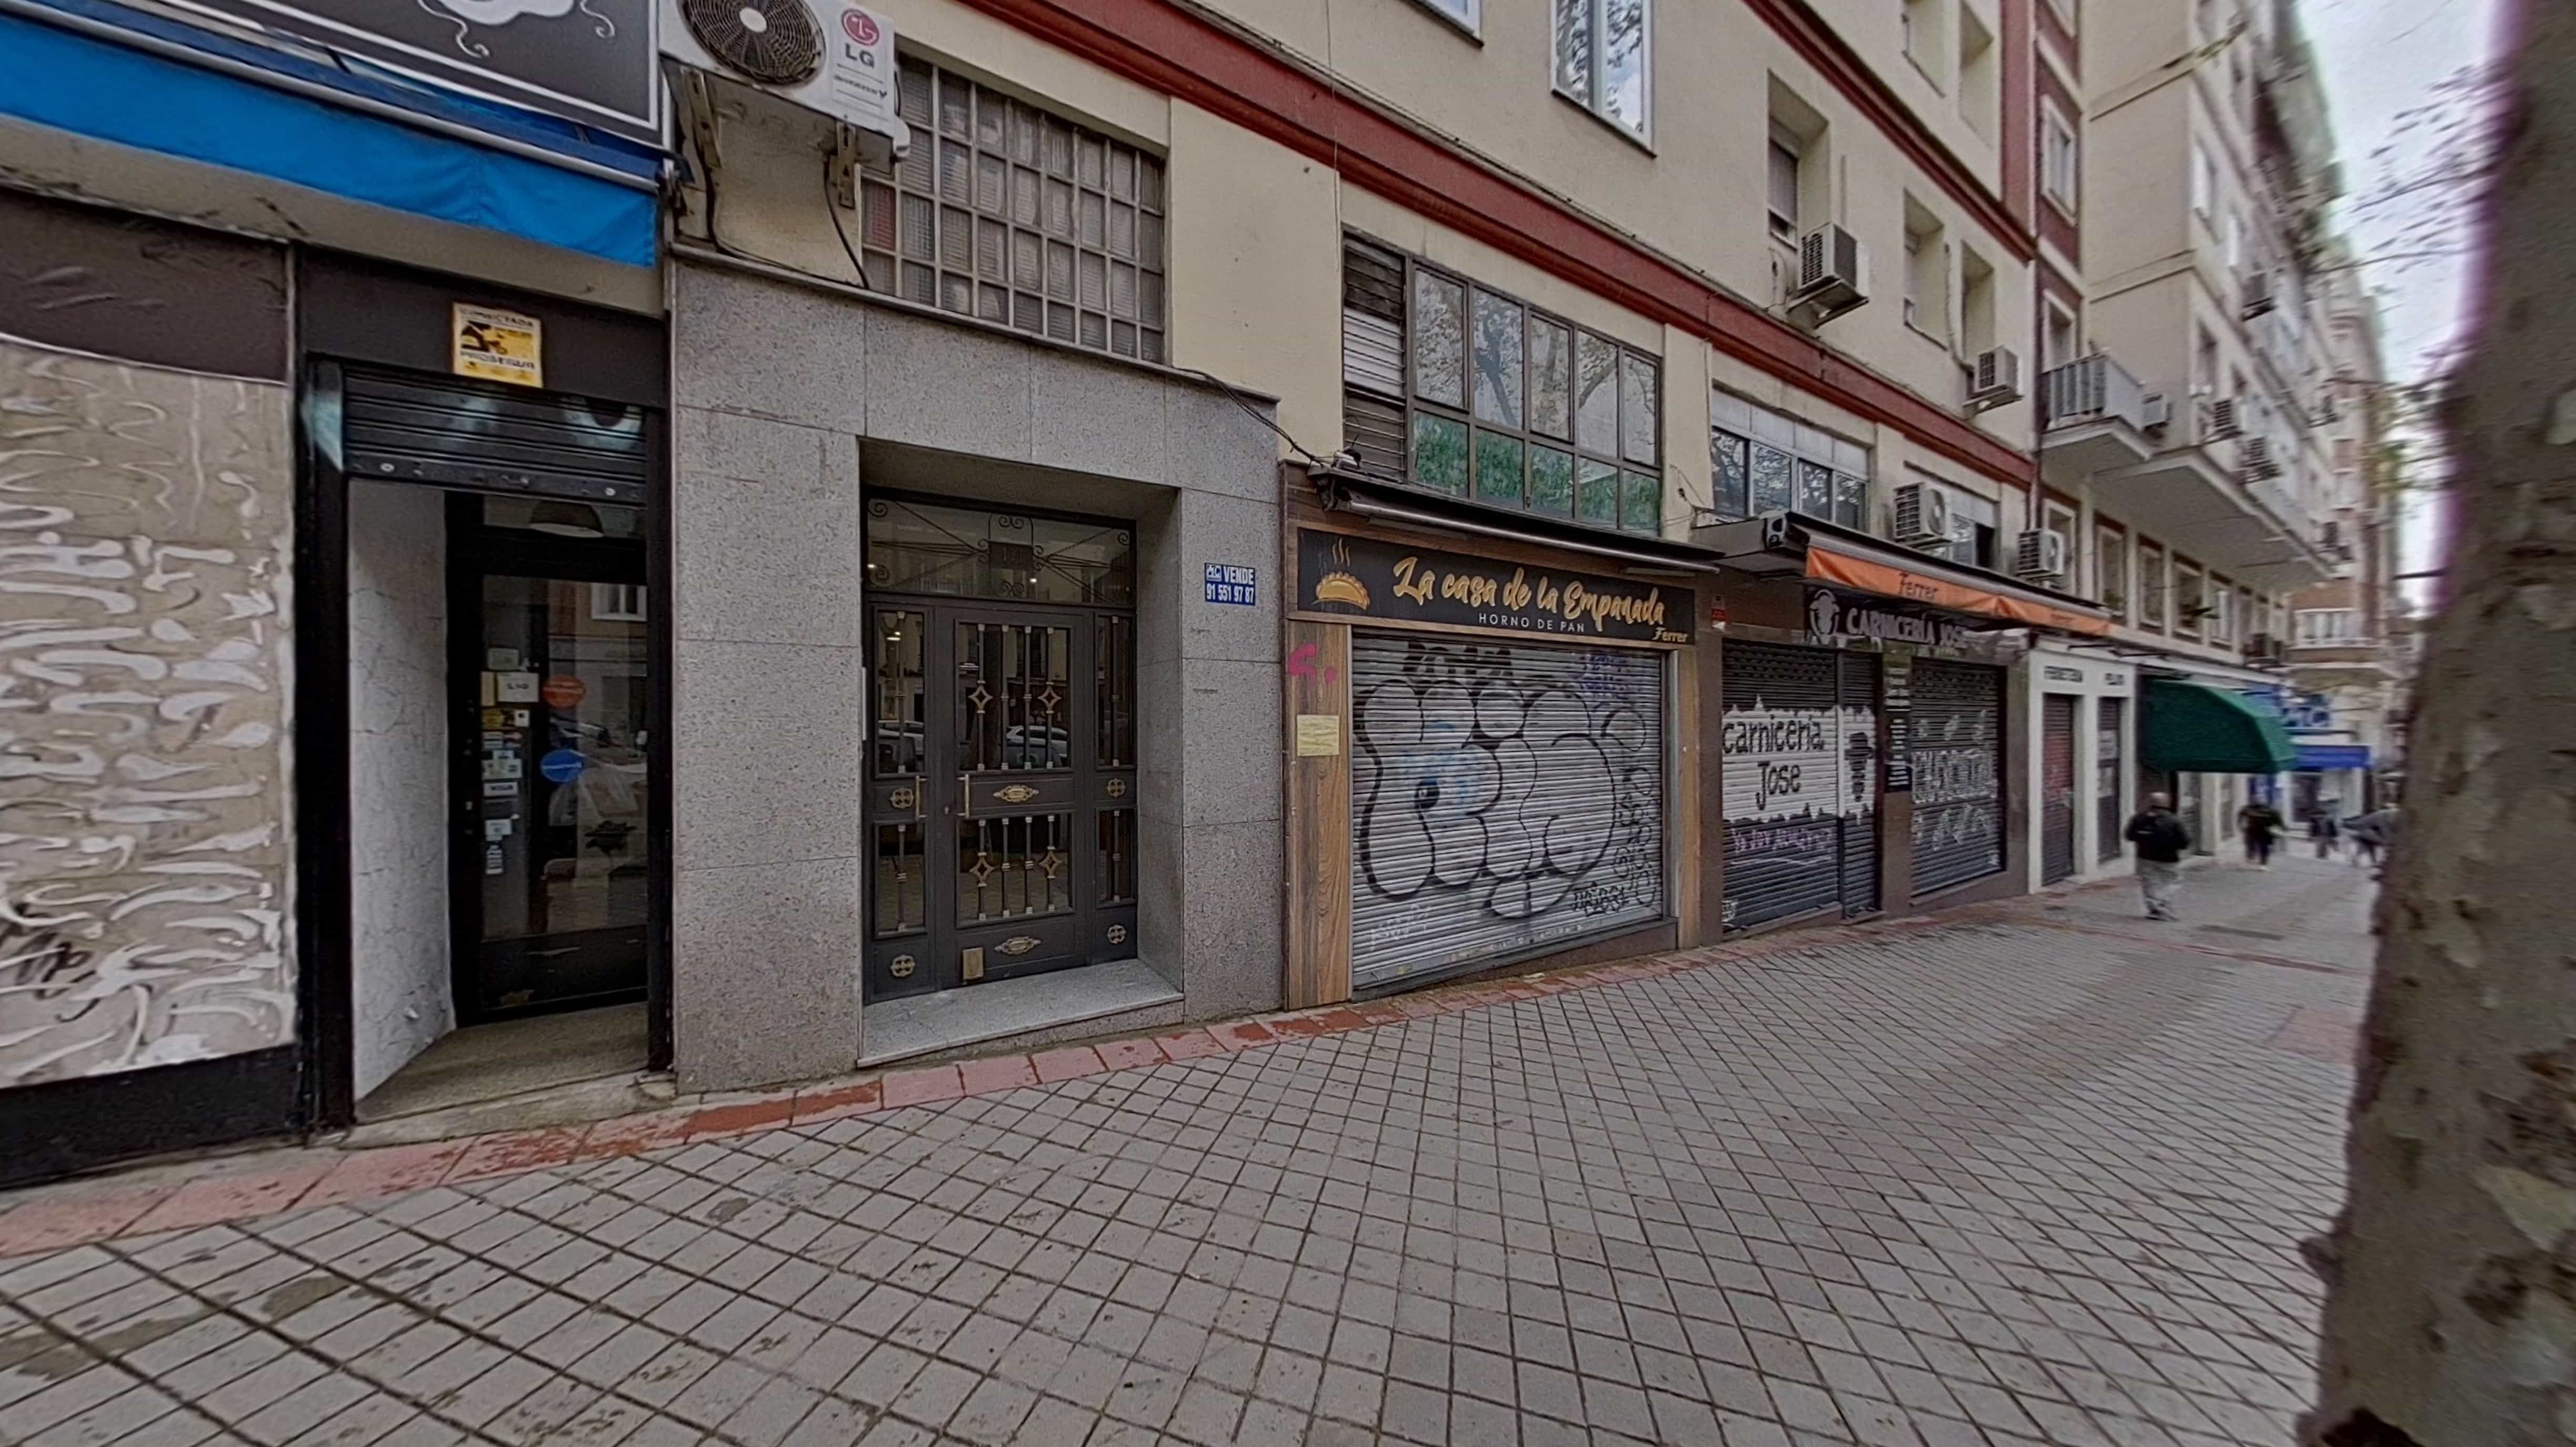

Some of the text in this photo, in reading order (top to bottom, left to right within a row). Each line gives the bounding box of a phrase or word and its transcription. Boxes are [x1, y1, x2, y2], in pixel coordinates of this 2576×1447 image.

[845, 42, 875, 69] LG
[1223, 566, 1254, 585] VENDE
[1898, 571, 1939, 600] Ferrer
[1206, 583, 1216, 600] 91
[1234, 586, 1243, 602] 97
[1245, 587, 1254, 603] 87
[1393, 556, 1665, 631] La casa de la Empanada
[1479, 613, 1584, 633] HORNO DE PAN
[1651, 627, 1688, 643] Ferrer
[1756, 761, 1801, 810] Jose
